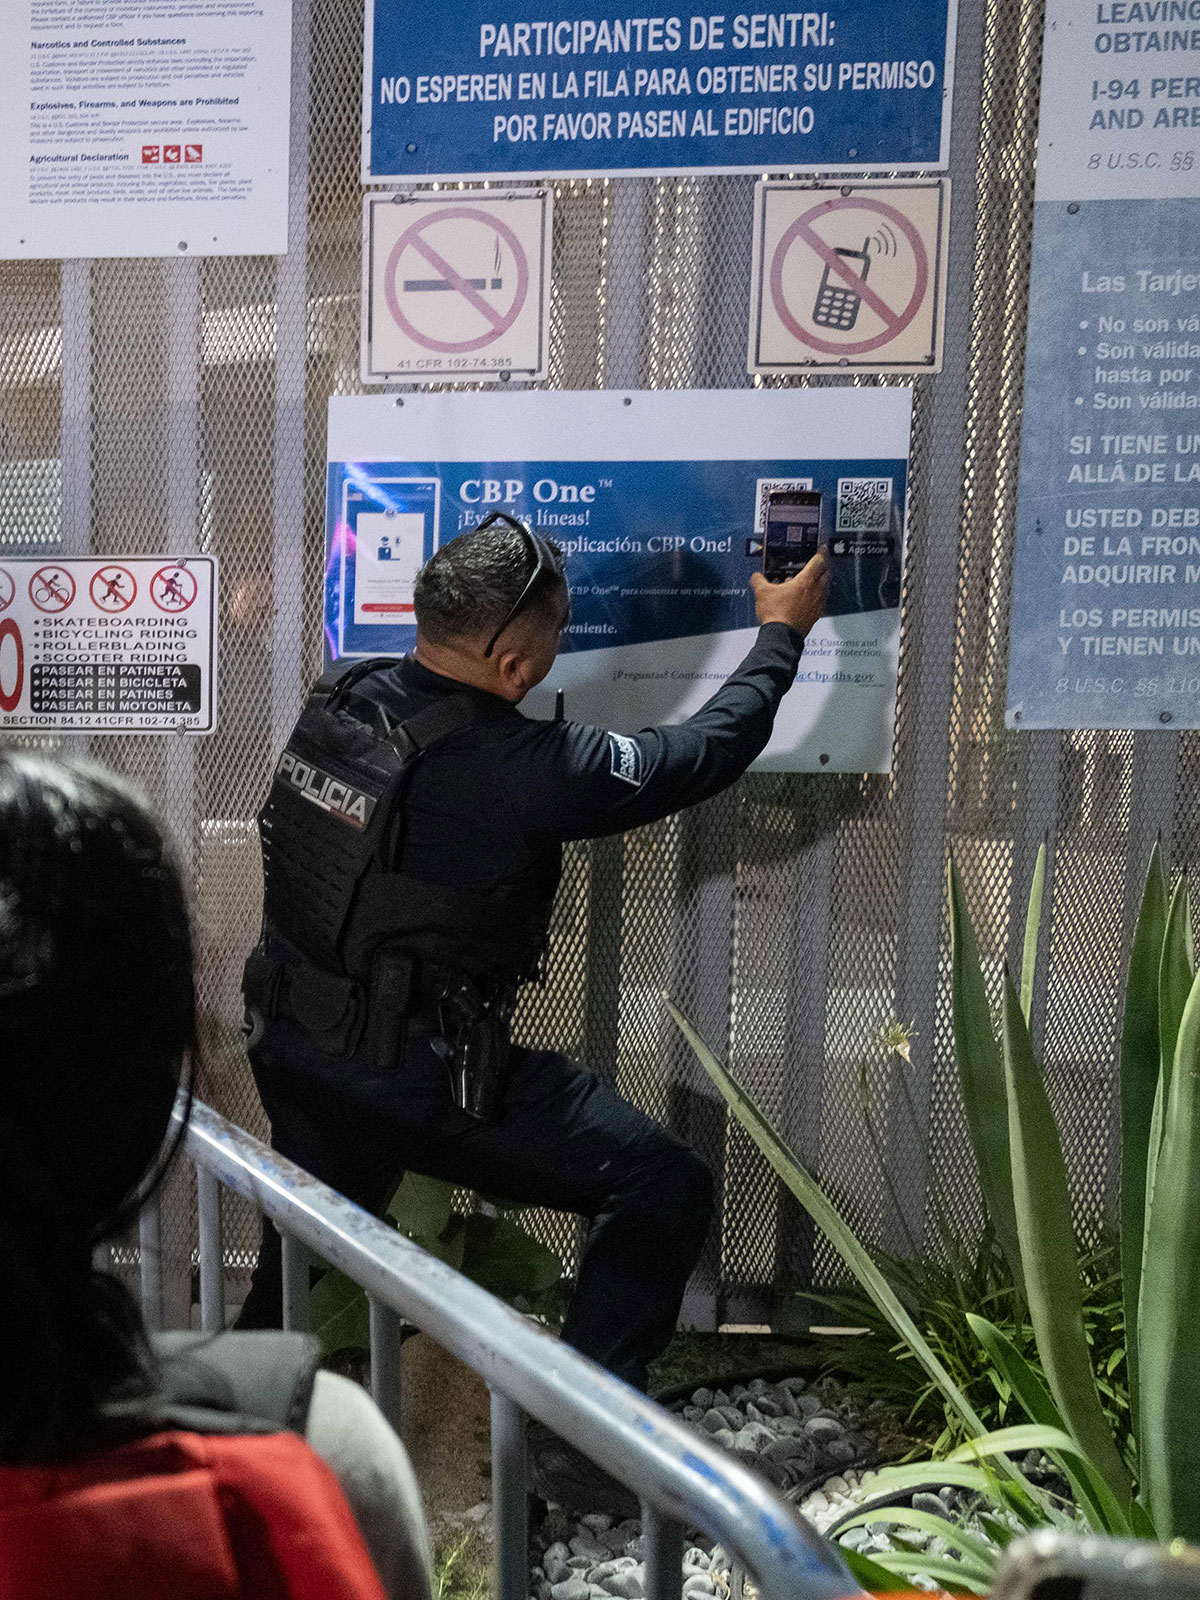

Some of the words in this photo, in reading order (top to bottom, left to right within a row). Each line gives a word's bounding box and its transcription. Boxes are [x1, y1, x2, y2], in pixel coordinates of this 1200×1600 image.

[479, 17, 681, 57] PARTICIPANTES
[690, 15, 725, 51] DE
[732, 12, 836, 50] SENTRI:
[31, 41, 71, 50] Narcotics
[73, 40, 88, 48] and
[91, 38, 134, 47] Controlled
[137, 37, 186, 46] Substances
[381, 76, 411, 104] NO
[416, 73, 512, 103] ESPEREN
[518, 72, 546, 100] EN
[552, 71, 579, 99] LA
[584, 69, 629, 98] FILA
[635, 67, 692, 96] PARA
[696, 64, 798, 95] OBTENER
[803, 63, 832, 92] SU
[838, 60, 935, 91] PERMISO
[1092, 79, 1140, 100] I-94
[120, 100, 136, 108] and
[139, 98, 177, 109] Weapons
[196, 97, 239, 106] Prohibited
[493, 114, 537, 143] POR
[542, 112, 612, 141] FAVOR
[617, 110, 686, 139] PASEN
[690, 109, 719, 137] AL
[725, 106, 814, 136] EDIFICIO
[1089, 108, 1144, 130] AND
[1152, 106, 1200, 129] ARE
[30, 153, 78, 164] Agricultural
[80, 152, 129, 162] Declaration
[1088, 153, 1101, 169] 8
[1108, 152, 1161, 169] U.S.C.
[1082, 271, 1126, 293] Las
[1136, 269, 1200, 296] Tarje
[1098, 316, 1126, 333] No
[1133, 318, 1169, 333] son
[1096, 342, 1135, 360] Son
[397, 360, 410, 369] 41
[416, 359, 442, 368] CFR
[448, 358, 513, 368] 102-74.385
[1095, 366, 1151, 384] hasta
[1159, 368, 1192, 386] por
[1093, 392, 1132, 410] Son
[1139, 391, 1200, 409] válida
[1069, 435, 1092, 455] SI
[1101, 434, 1168, 455] TIENE
[1067, 459, 1125, 483] ALLÁ
[1134, 463, 1166, 483] DE
[459, 479, 524, 503] CBP
[537, 509, 590, 526] líneas!
[1065, 508, 1143, 528] USTED
[560, 535, 641, 557] aplicación
[648, 536, 686, 553] CBP
[690, 536, 732, 553] One!
[1064, 536, 1095, 556] DE
[1103, 536, 1132, 556] LA
[1061, 564, 1176, 587] ADQUIRIR
[570, 586, 588, 595] CBP
[42, 618, 188, 627] SKATEBOARDING
[1060, 608, 1102, 628] LOS
[43, 630, 133, 639] BICYCLING
[140, 630, 197, 639] RIDING
[562, 623, 618, 635] veniente.
[43, 642, 186, 650] ROLLERBLADING
[820, 638, 859, 647] Customs
[861, 638, 878, 647] and
[1058, 636, 1073, 655] Y
[1080, 636, 1164, 656] TIENEN
[42, 654, 123, 662] SCOOTER
[130, 654, 188, 662] RIDING
[835, 648, 881, 657] Protection
[41, 666, 93, 676] PASEAR
[98, 666, 115, 676] EN
[119, 666, 181, 676] PATINETA
[41, 678, 93, 688] PASEAR
[98, 678, 115, 688] EN
[119, 678, 187, 688] BICICLETA
[41, 690, 93, 699] PASEAR
[98, 690, 115, 699] EN
[119, 690, 173, 699] PATINES
[41, 701, 93, 711] PASEAR
[98, 701, 115, 711] EN
[119, 701, 191, 711] MOTONETA
[3, 716, 57, 725] SECTION
[61, 716, 91, 725] 84.12
[95, 716, 133, 725] 41CFR
[138, 716, 200, 726] 102-74.385
[277, 752, 366, 823] POLICIA
